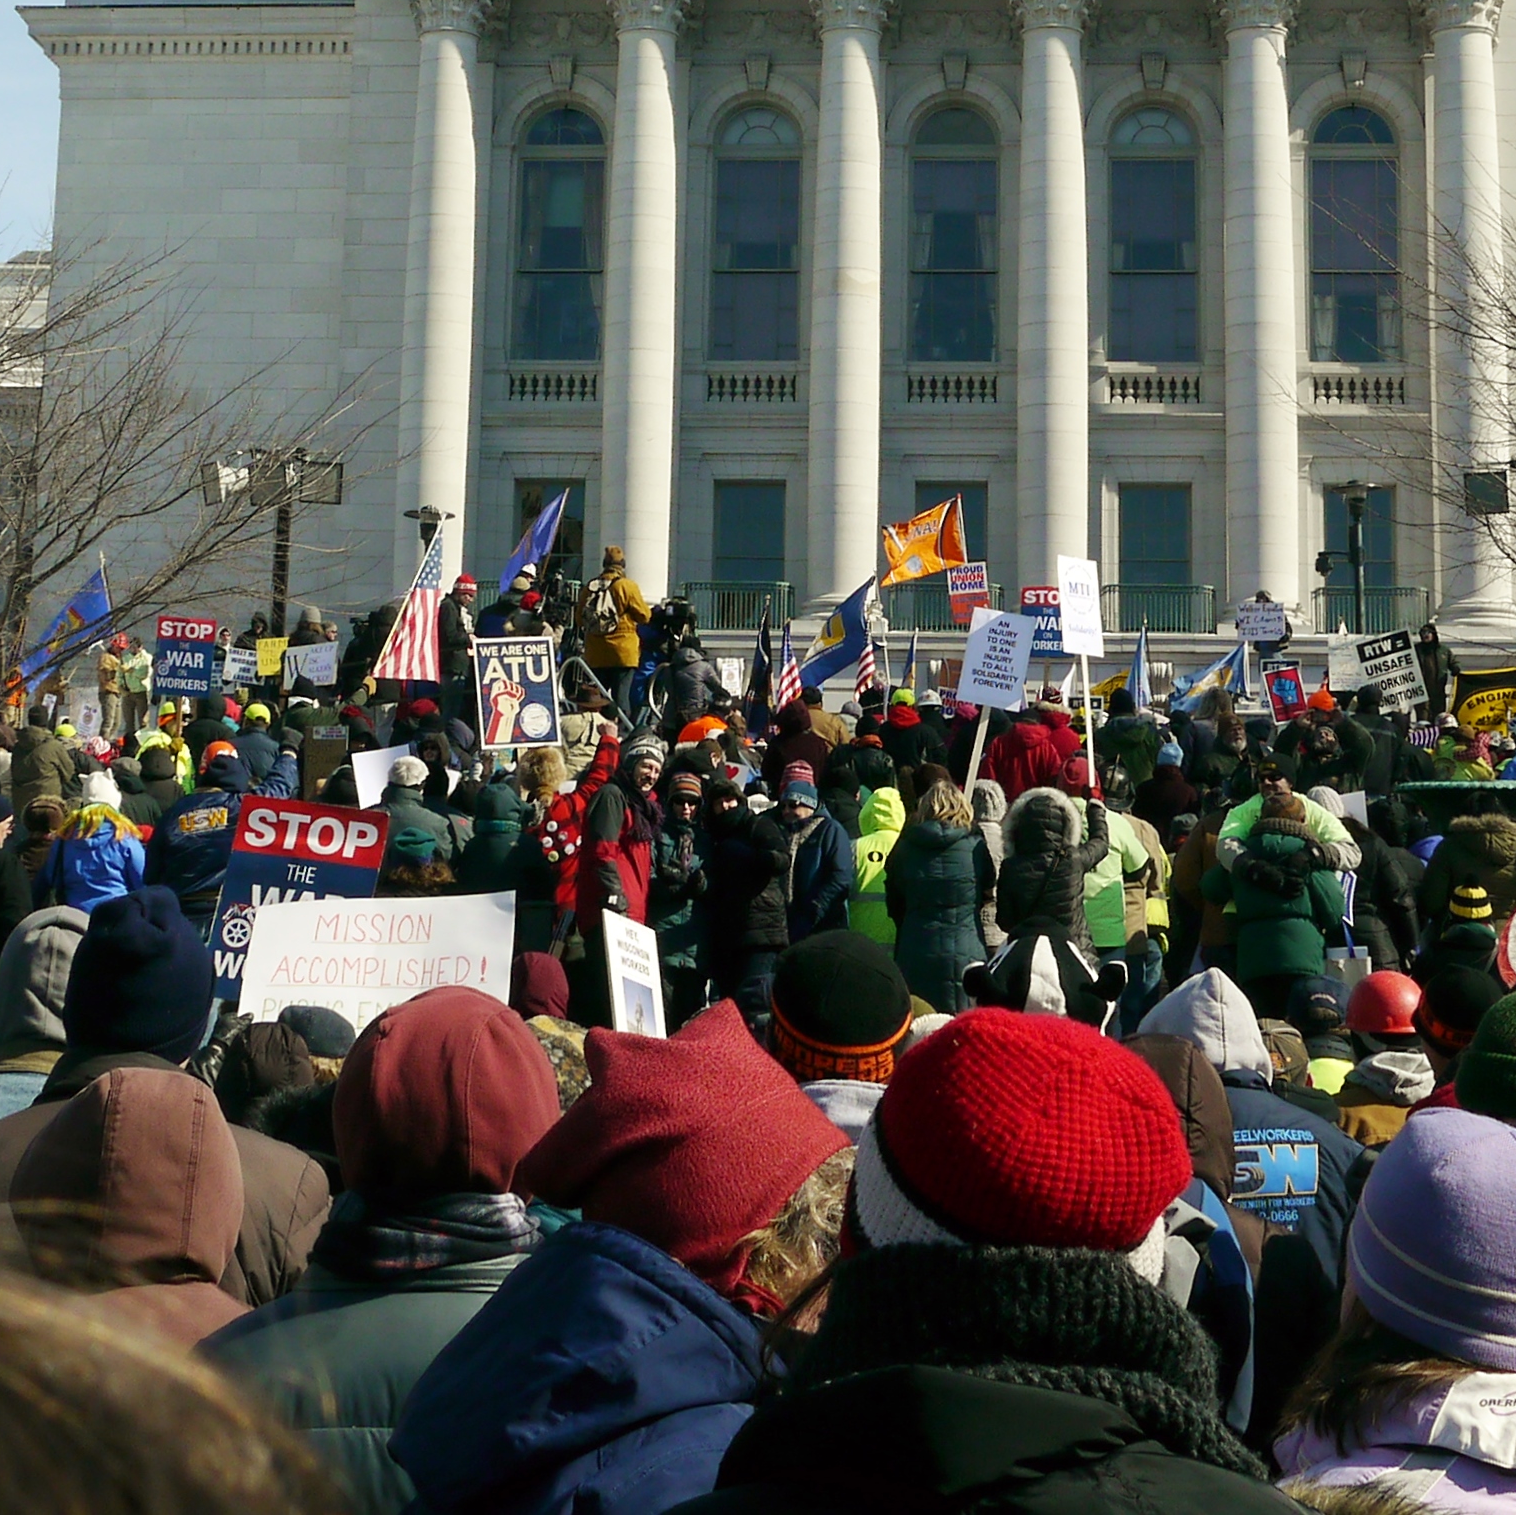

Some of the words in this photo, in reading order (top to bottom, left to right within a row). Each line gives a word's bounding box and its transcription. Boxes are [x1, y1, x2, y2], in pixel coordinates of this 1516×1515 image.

[949, 565, 984, 575] PROUD
[950, 573, 985, 583] UNION
[950, 581, 986, 592] HOME
[1024, 589, 1060, 605] STO
[160, 620, 214, 640] STOP
[998, 620, 1010, 628] AN
[989, 628, 1018, 638] INJURY
[987, 636, 998, 644] TO
[999, 638, 1017, 647] ONE
[1364, 638, 1393, 659] RTW
[479, 646, 499, 657] WE
[501, 645, 523, 656] ARE
[524, 644, 548, 655] ONE
[998, 646, 1011, 655] AN
[166, 650, 205, 669] WAR
[984, 653, 1014, 664] INJURY
[1364, 653, 1414, 677] UNSAFE
[482, 655, 550, 685] ATU
[972, 668, 1019, 684] SOLIDARITY
[155, 676, 208, 692] WORKERS
[973, 677, 1014, 692] FOREVER!
[244, 808, 379, 859] STOP
[286, 863, 318, 885] THE
[315, 913, 433, 942] MISSION
[1233, 1128, 1315, 1142] EELWORKERS
